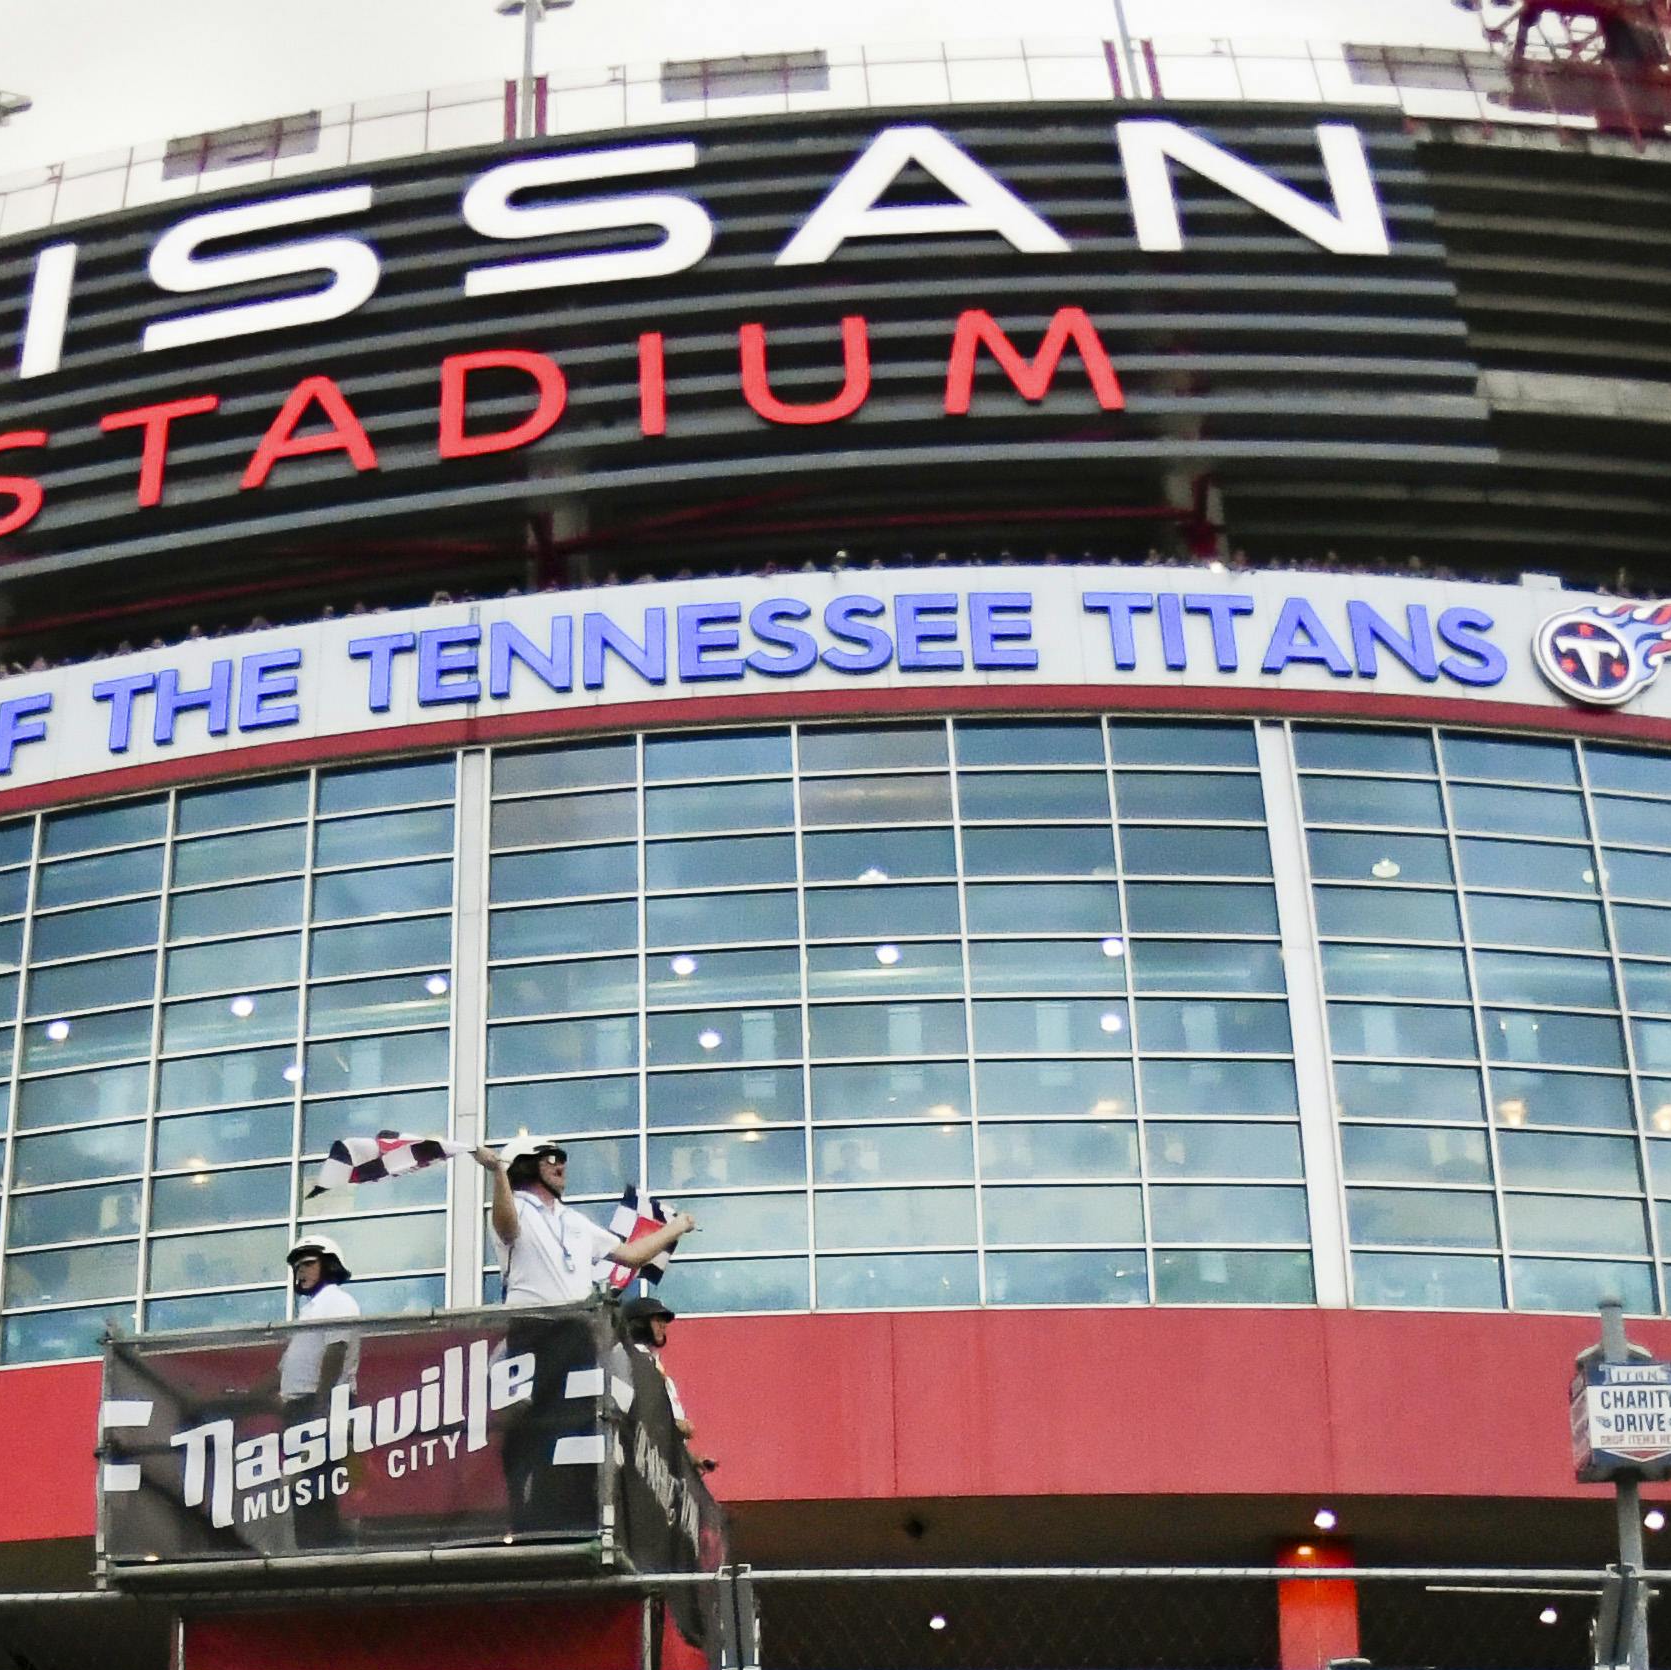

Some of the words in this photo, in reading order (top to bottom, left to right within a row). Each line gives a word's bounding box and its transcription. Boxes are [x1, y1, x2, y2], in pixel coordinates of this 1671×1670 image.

[93, 649, 301, 753] THE
[348, 591, 1039, 713] TENNESSEE
[1084, 591, 1507, 687] TITANS
[171, 1339, 535, 1529] Nashville
[243, 1465, 350, 1523] MUSIC
[386, 1430, 462, 1480] CITY
[1614, 1414, 1666, 1432] DRIVE
